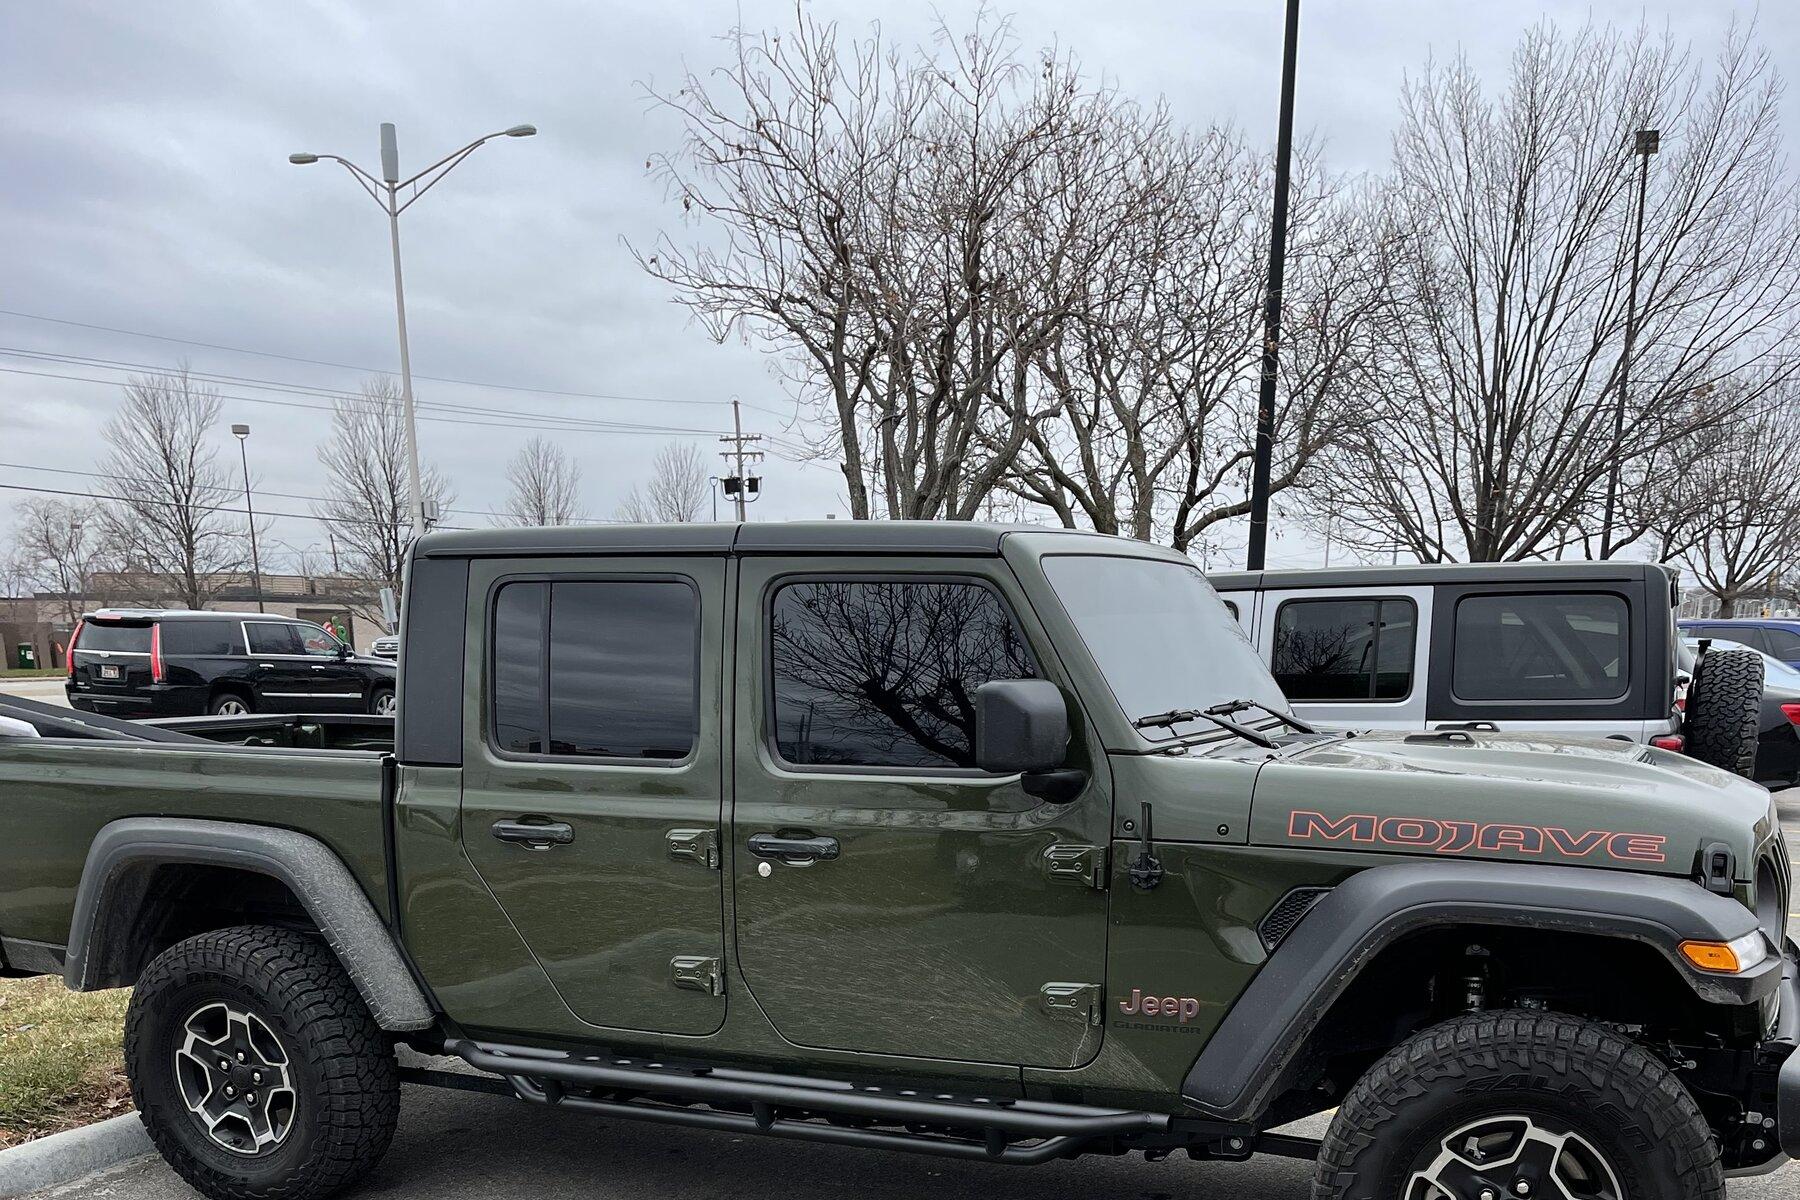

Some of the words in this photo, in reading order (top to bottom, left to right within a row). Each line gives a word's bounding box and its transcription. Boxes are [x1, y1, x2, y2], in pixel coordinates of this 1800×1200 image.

[1288, 811, 1666, 862] MOJAVE
[1119, 988, 1200, 1024] Jeep
[1113, 1021, 1201, 1034] GLADIATOR
